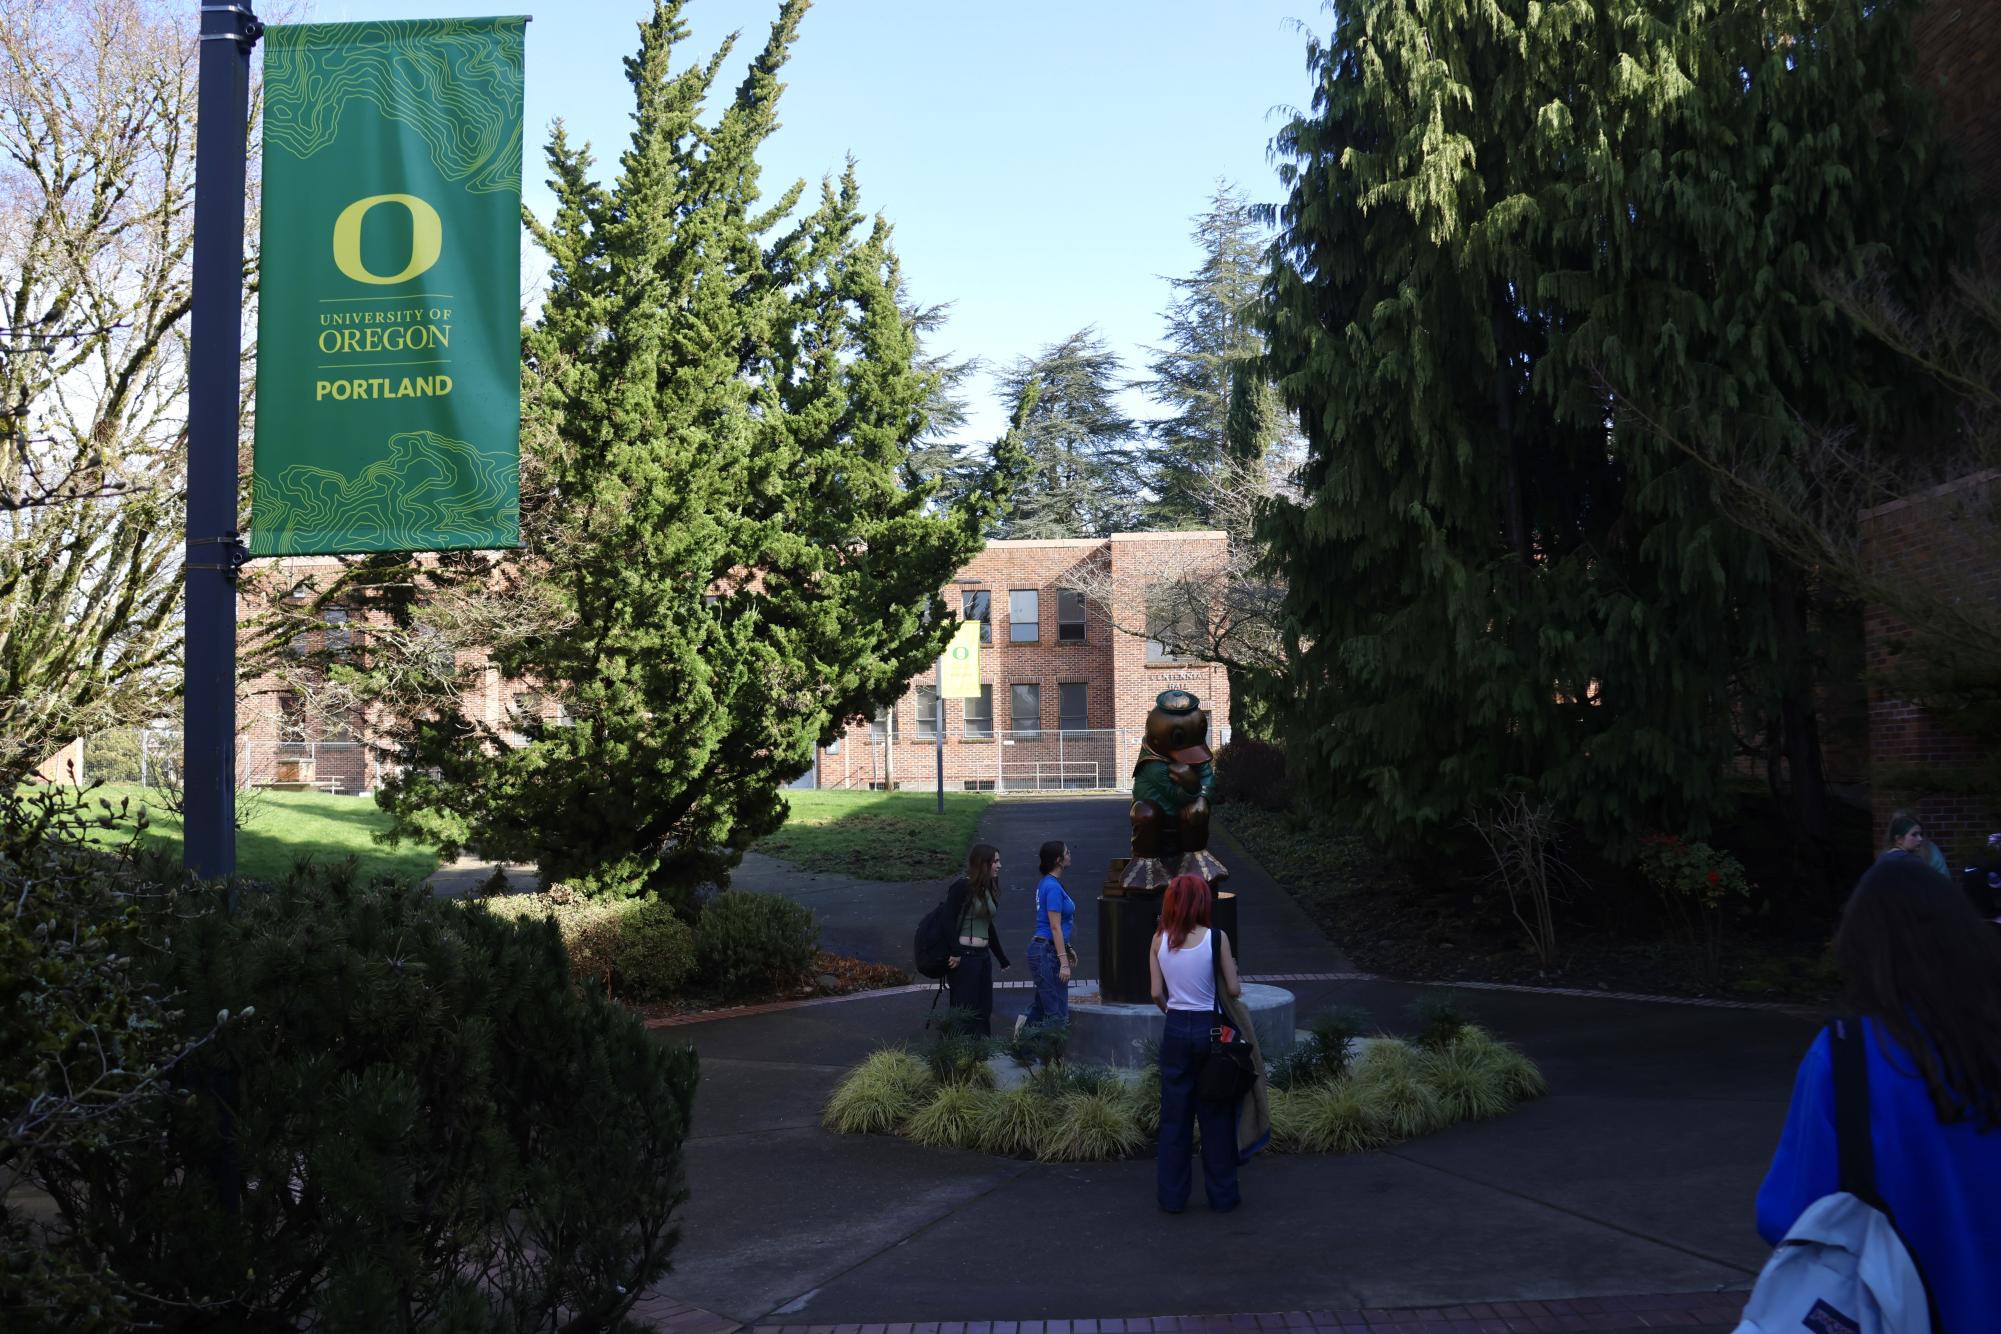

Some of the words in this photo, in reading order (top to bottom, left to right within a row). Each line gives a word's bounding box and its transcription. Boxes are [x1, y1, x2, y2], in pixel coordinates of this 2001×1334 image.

[333, 193, 442, 285] O
[320, 309, 423, 325] UNIVERSITY
[429, 308, 452, 321] OF
[318, 325, 452, 353] OREGON
[316, 375, 453, 401] PORTLAND
[952, 646, 969, 660] O
